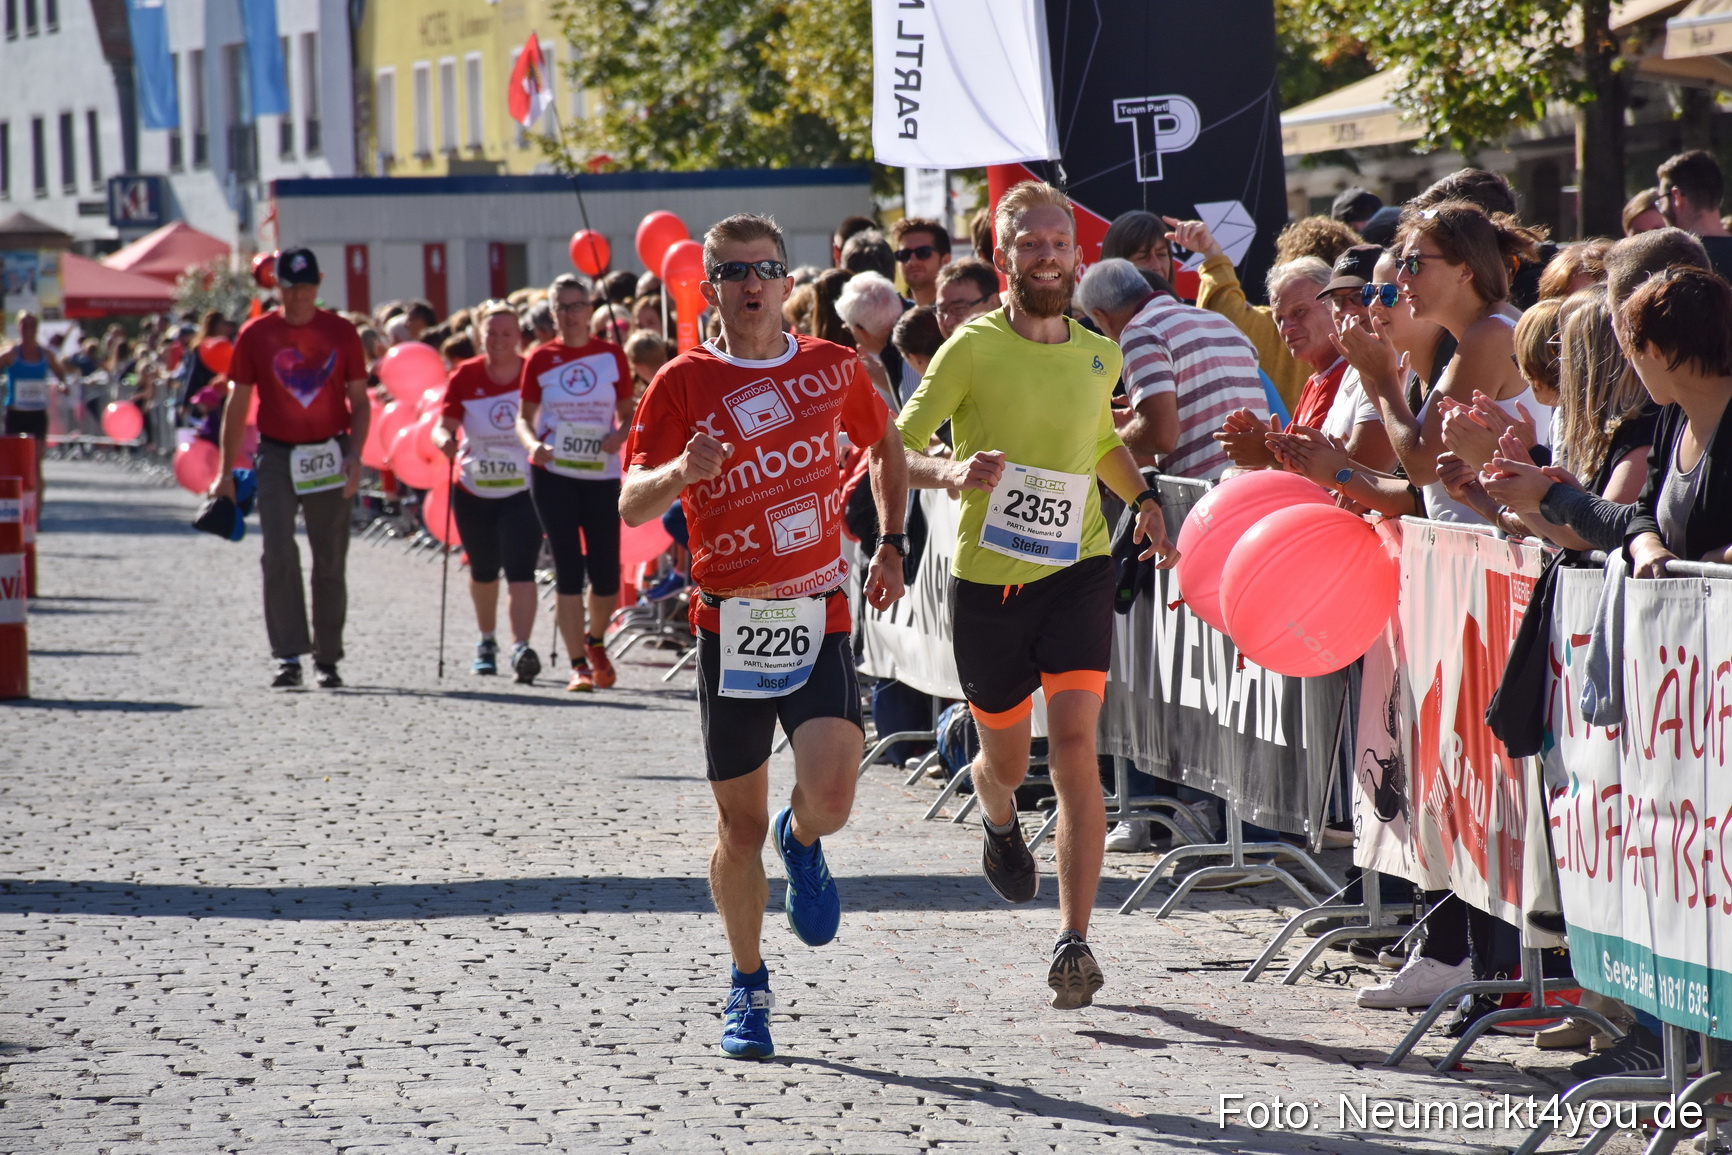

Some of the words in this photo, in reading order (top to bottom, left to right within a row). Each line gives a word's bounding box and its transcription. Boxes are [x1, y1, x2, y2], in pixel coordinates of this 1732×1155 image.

[1120, 105, 1146, 114] Team
[727, 382, 773, 407] raumbox
[562, 437, 602, 455] 5070
[300, 452, 335, 474] 5073
[480, 460, 516, 474] 5170
[735, 484, 784, 507] wohnen
[793, 464, 832, 487] outdoor
[1025, 475, 1067, 492] BOCK
[769, 499, 816, 521] raumbox
[1003, 489, 1072, 528] 2353
[1006, 520, 1027, 532] PARTL
[1027, 527, 1055, 537] Neumarkt
[1011, 536, 1049, 555] Stefan
[775, 565, 838, 599] raumbox
[750, 607, 797, 620] BOCK
[736, 625, 811, 658] 2226
[743, 660, 764, 669] PARTL
[757, 675, 790, 690] Josef
